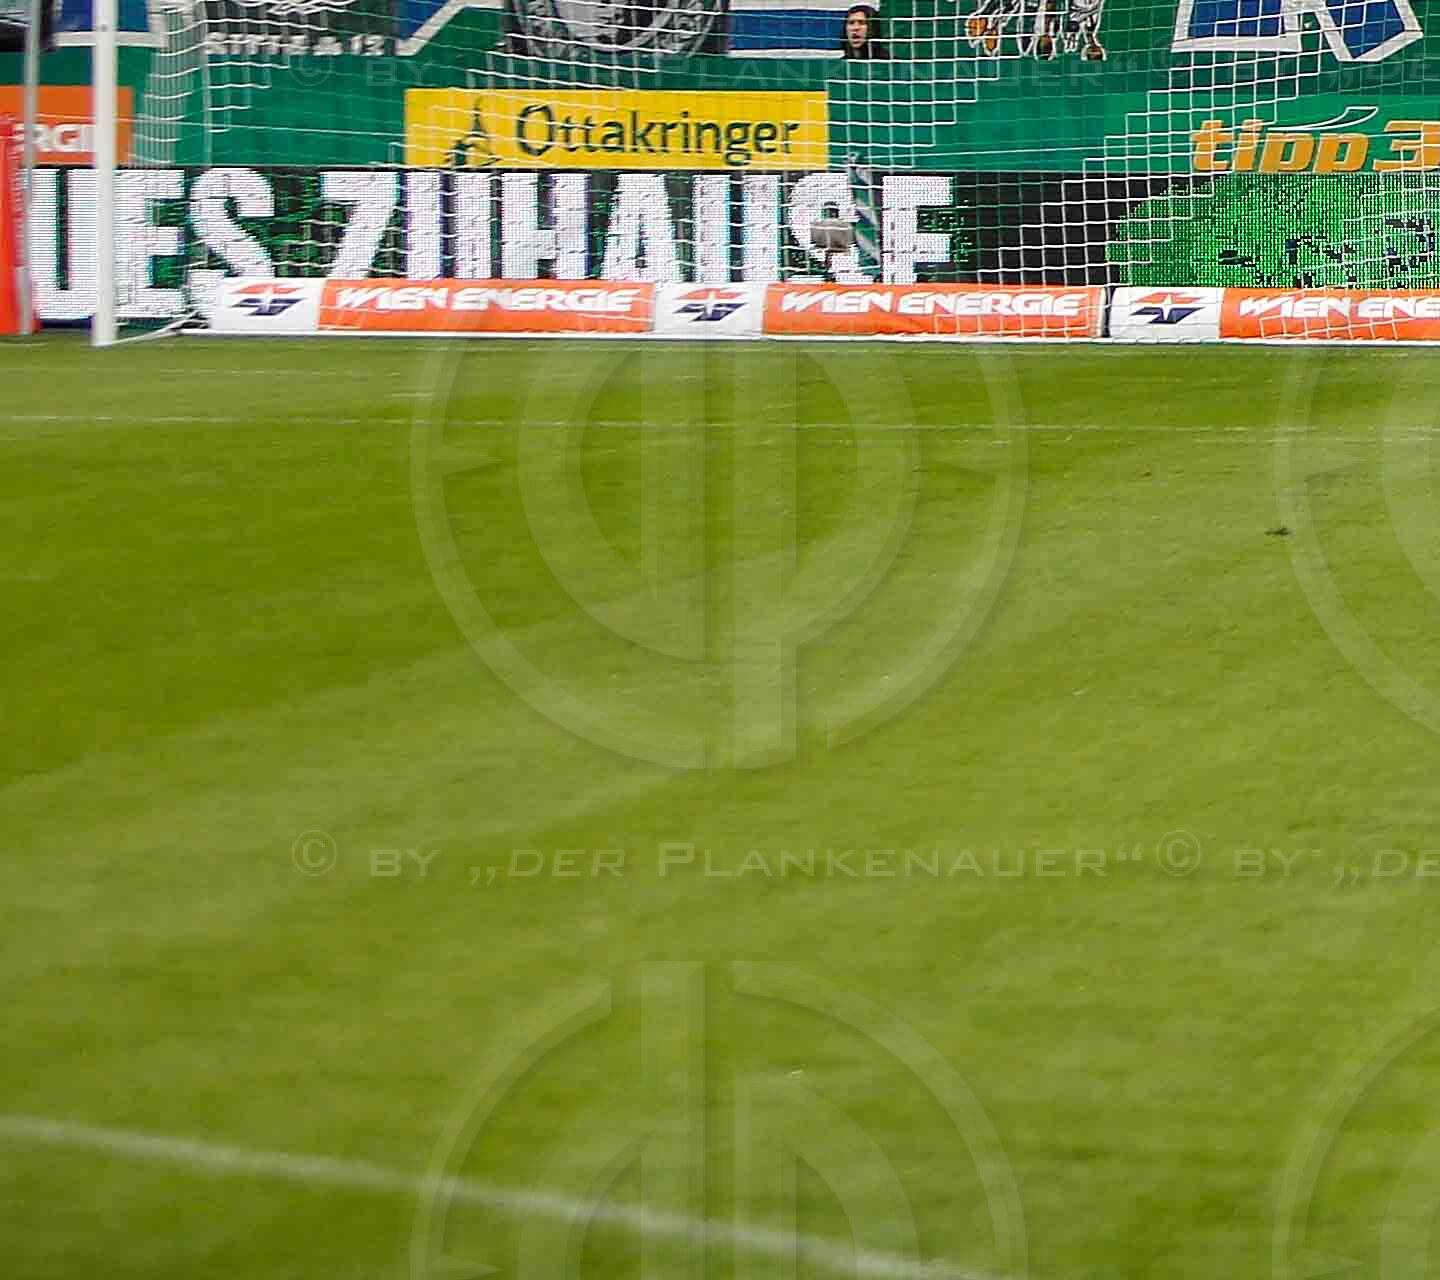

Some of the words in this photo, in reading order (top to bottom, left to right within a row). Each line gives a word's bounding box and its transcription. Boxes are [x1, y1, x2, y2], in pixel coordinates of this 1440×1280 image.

[516, 102, 800, 167] Ottakringer
[336, 287, 447, 311] WIEN
[450, 287, 641, 313] ENERGIE
[781, 290, 896, 313] WIEN
[899, 292, 1084, 316] ENERGIE
[1239, 295, 1356, 318] WIEN
